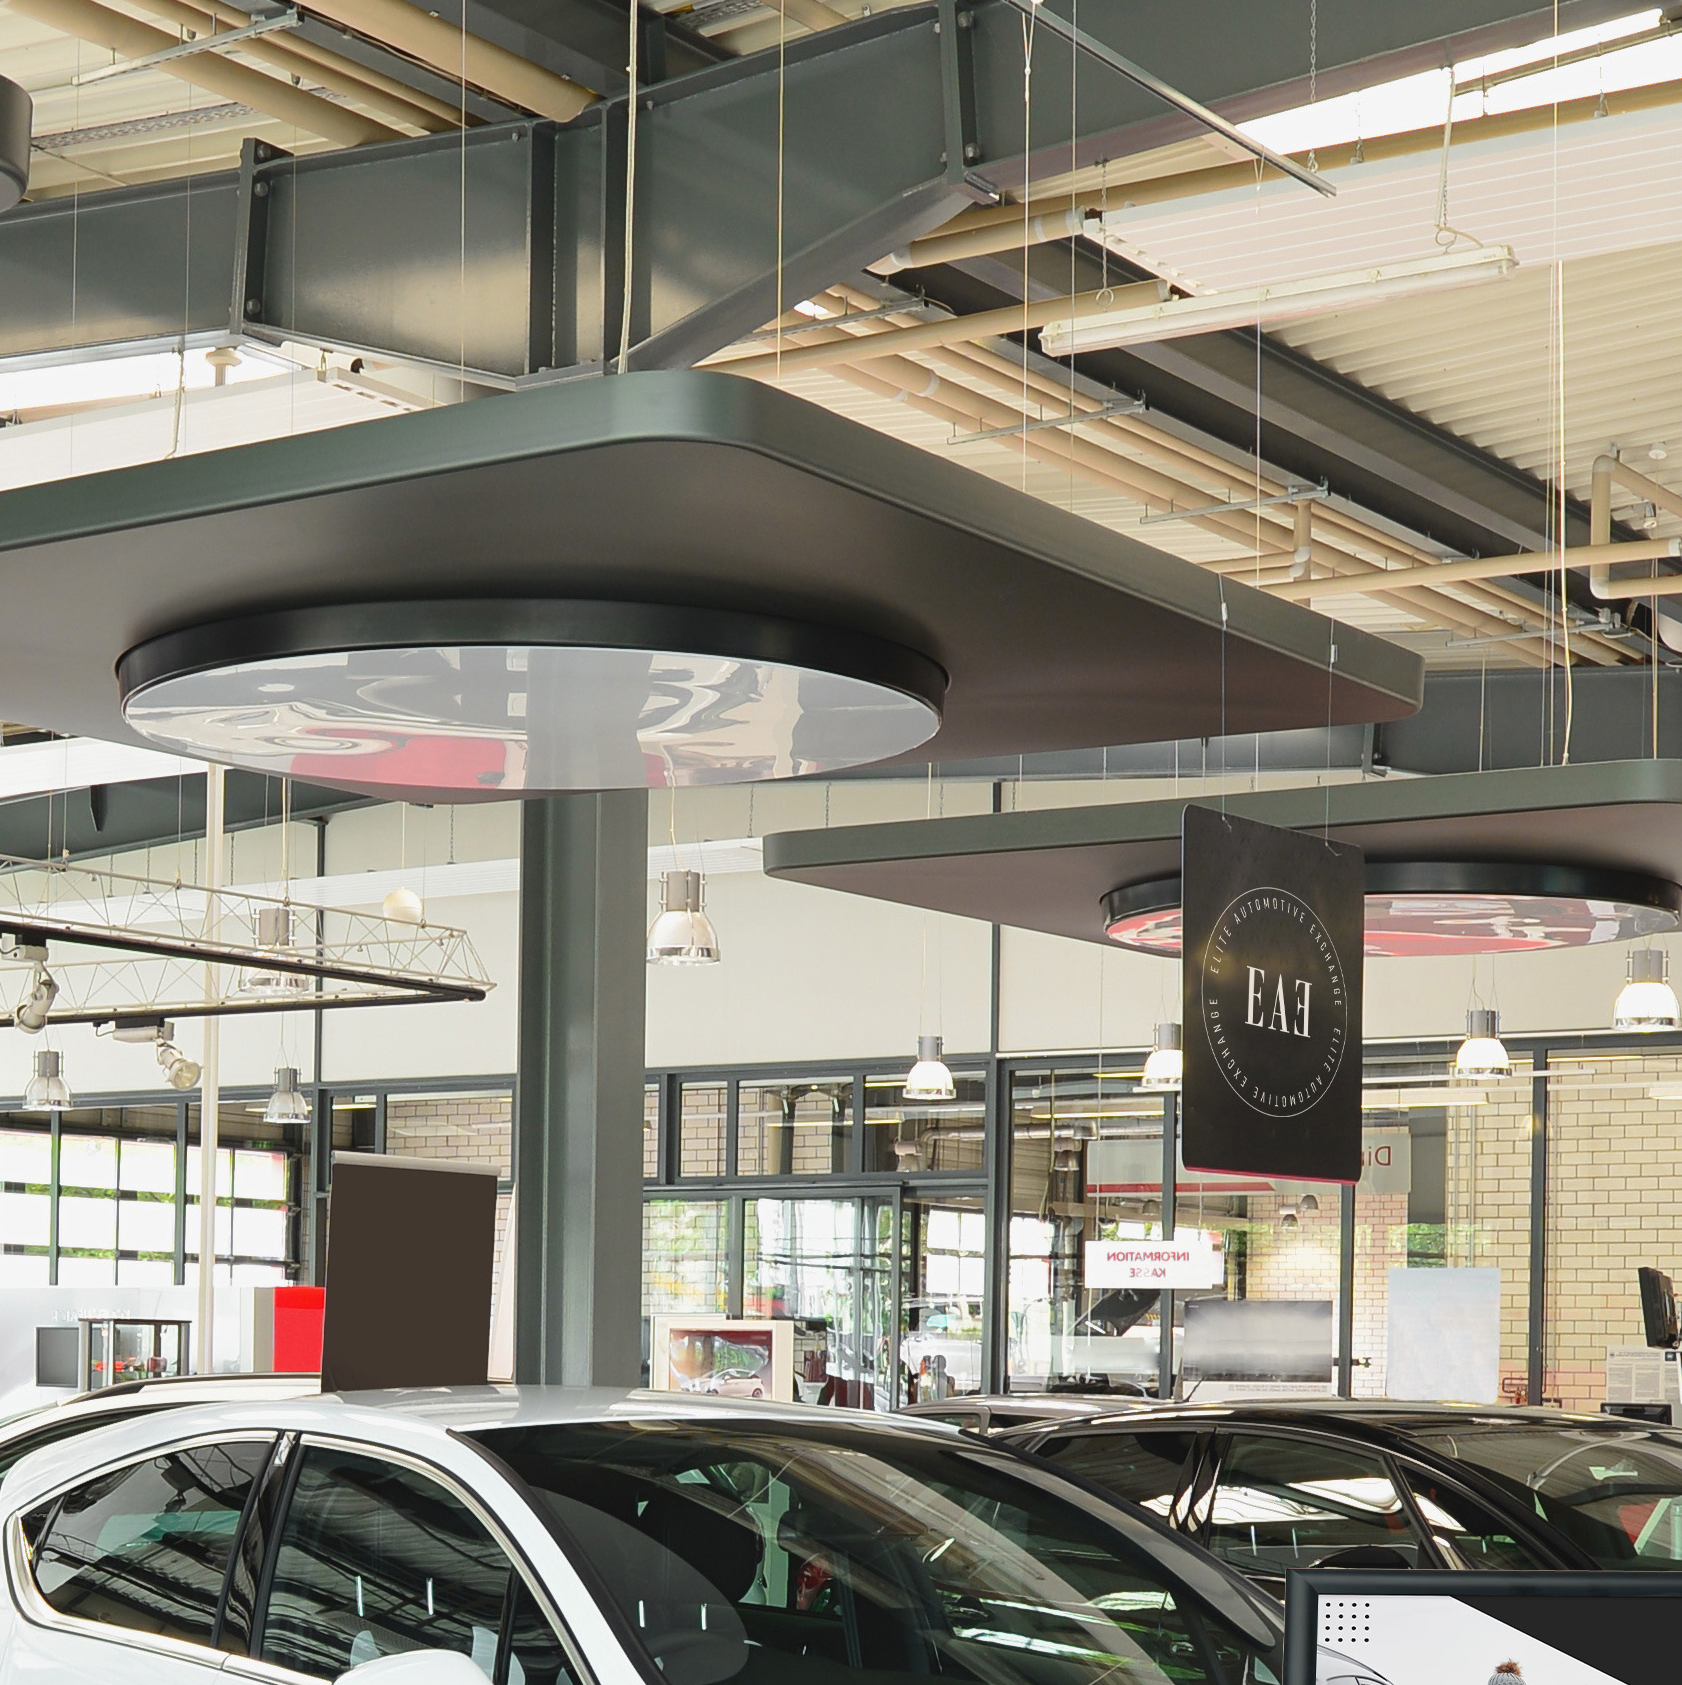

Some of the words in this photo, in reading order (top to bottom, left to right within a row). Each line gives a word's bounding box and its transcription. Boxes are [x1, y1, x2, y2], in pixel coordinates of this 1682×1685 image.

[1210, 925, 1232, 974] ELITE
[1233, 897, 1306, 924] AUTOMOTIVE
[1309, 923, 1342, 1006] EXCHANGE
[1209, 998, 1248, 1088] EXCHANGE
[1323, 1027, 1342, 1073] ELITE
[1252, 1074, 1323, 1108] AUTOMOTIVE
